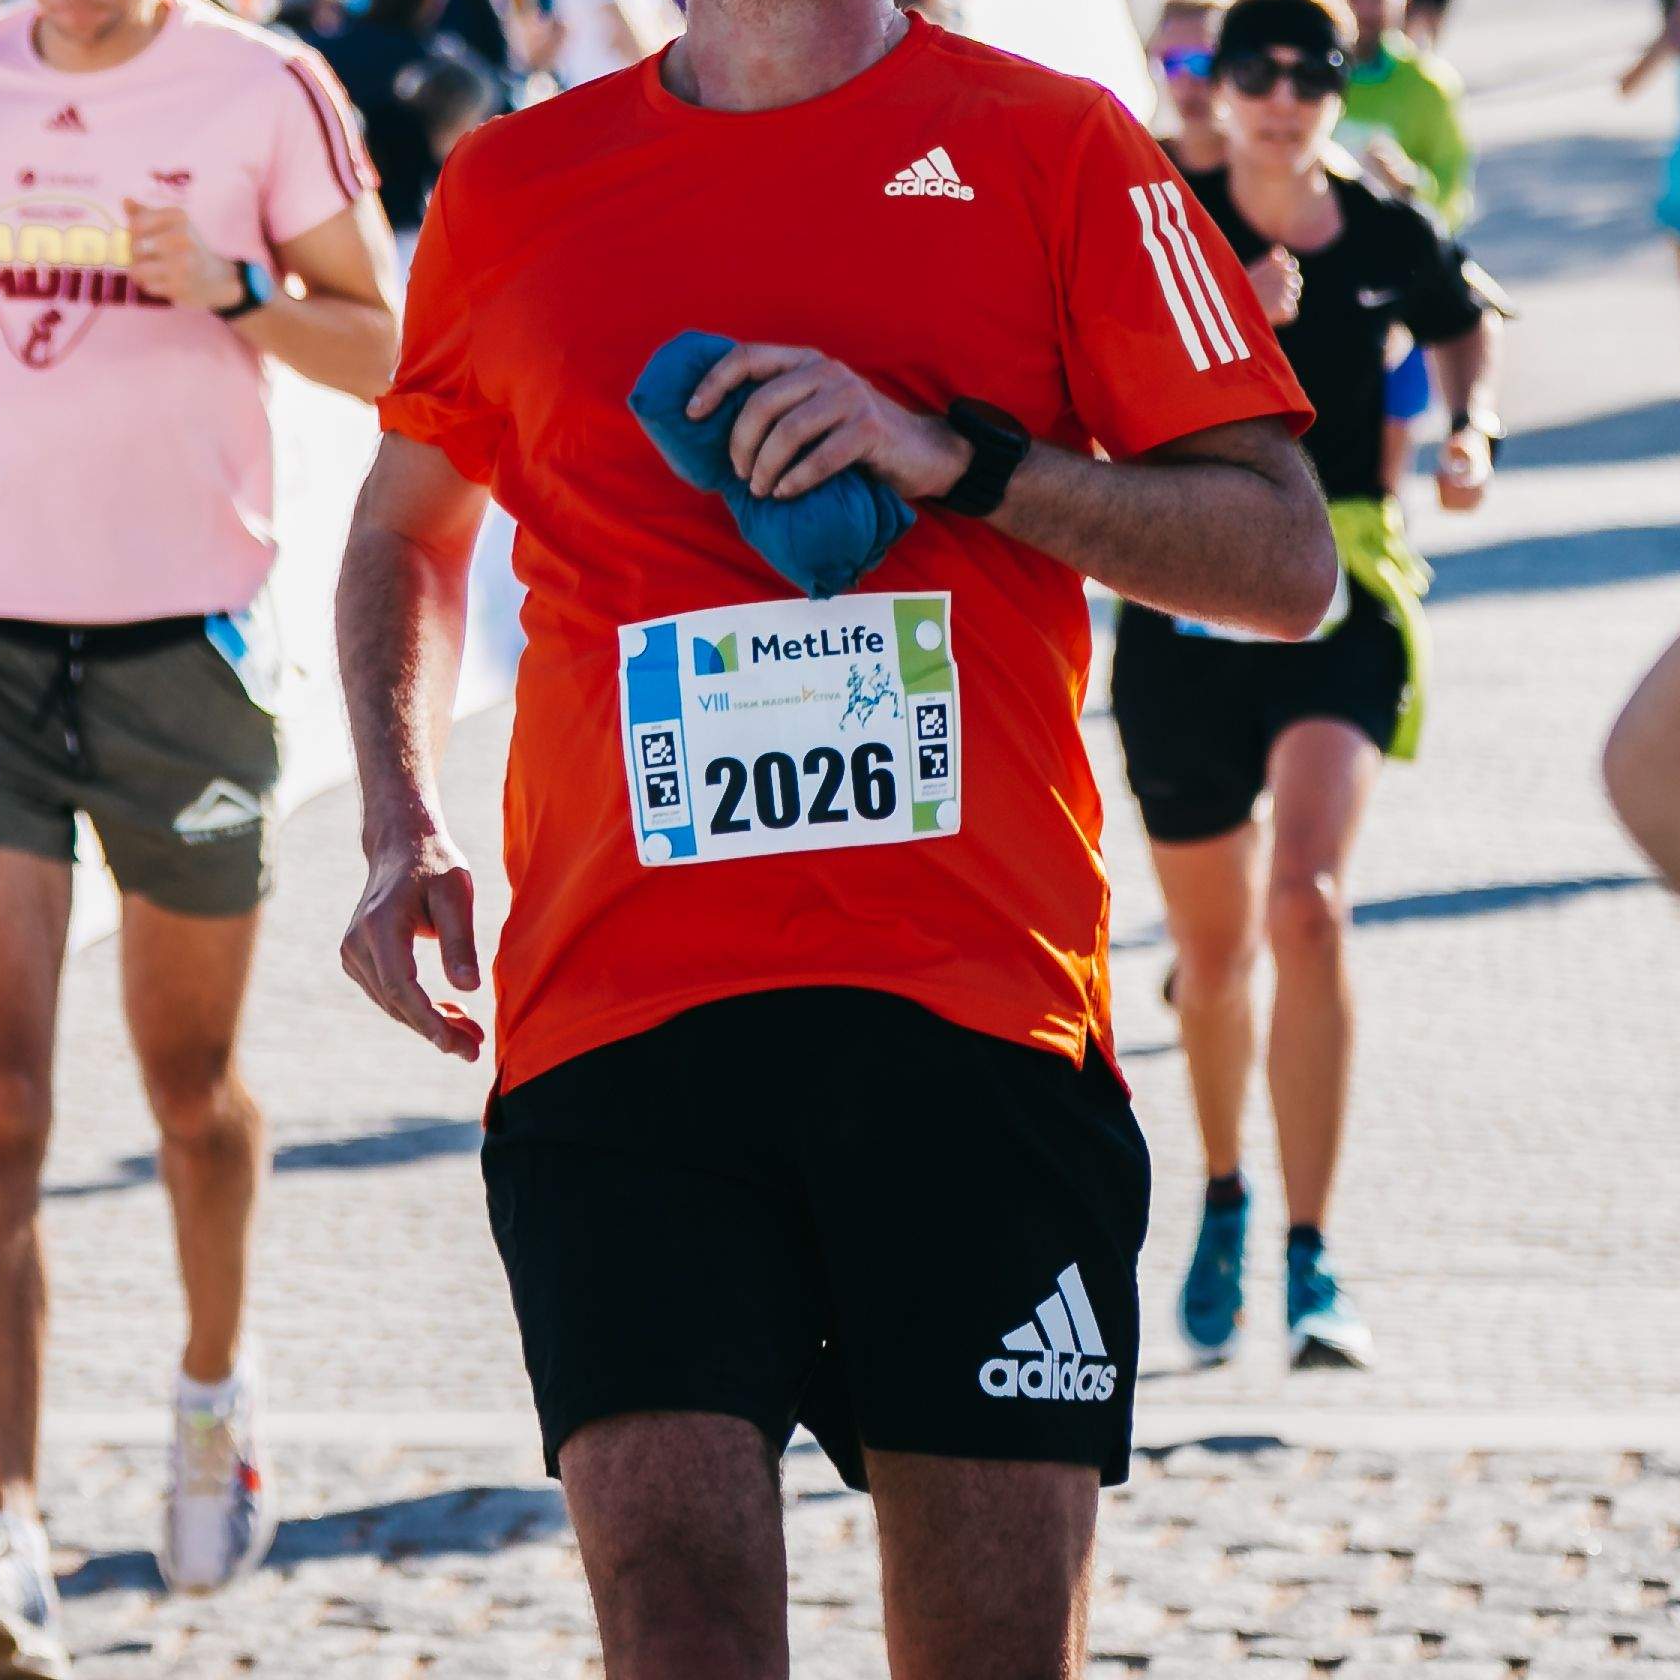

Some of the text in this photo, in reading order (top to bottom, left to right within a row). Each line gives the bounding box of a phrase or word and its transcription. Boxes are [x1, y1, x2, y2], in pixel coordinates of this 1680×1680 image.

[884, 176, 975, 201] adidas
[751, 625, 884, 664] MetLife
[696, 691, 731, 713] VIII
[704, 742, 897, 836] 2026
[978, 1350, 1118, 1401] adidas
